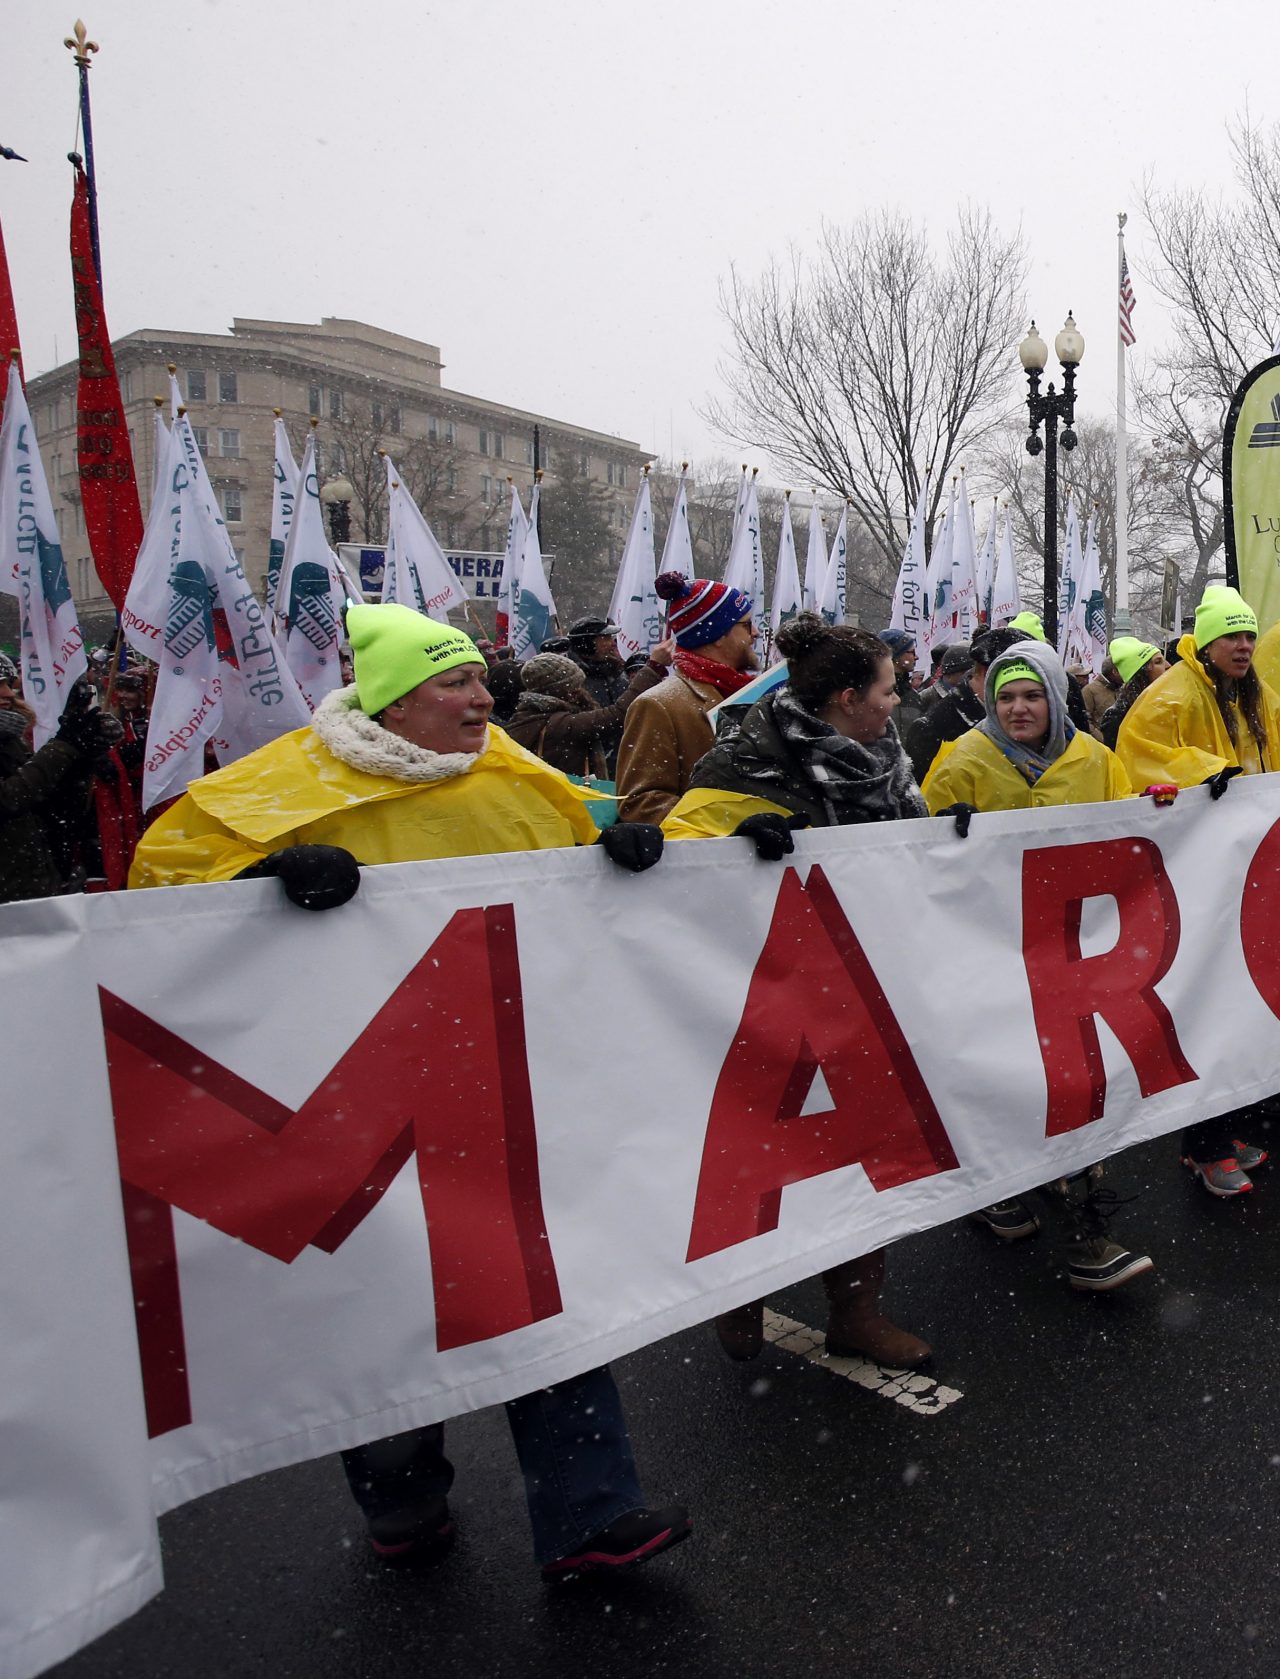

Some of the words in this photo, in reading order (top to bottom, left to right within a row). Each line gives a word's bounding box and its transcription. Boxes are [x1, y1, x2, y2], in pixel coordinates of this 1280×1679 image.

[448, 557, 503, 577] HERA
[424, 639, 454, 655] March
[431, 651, 451, 663] with
[452, 646, 465, 655] the
